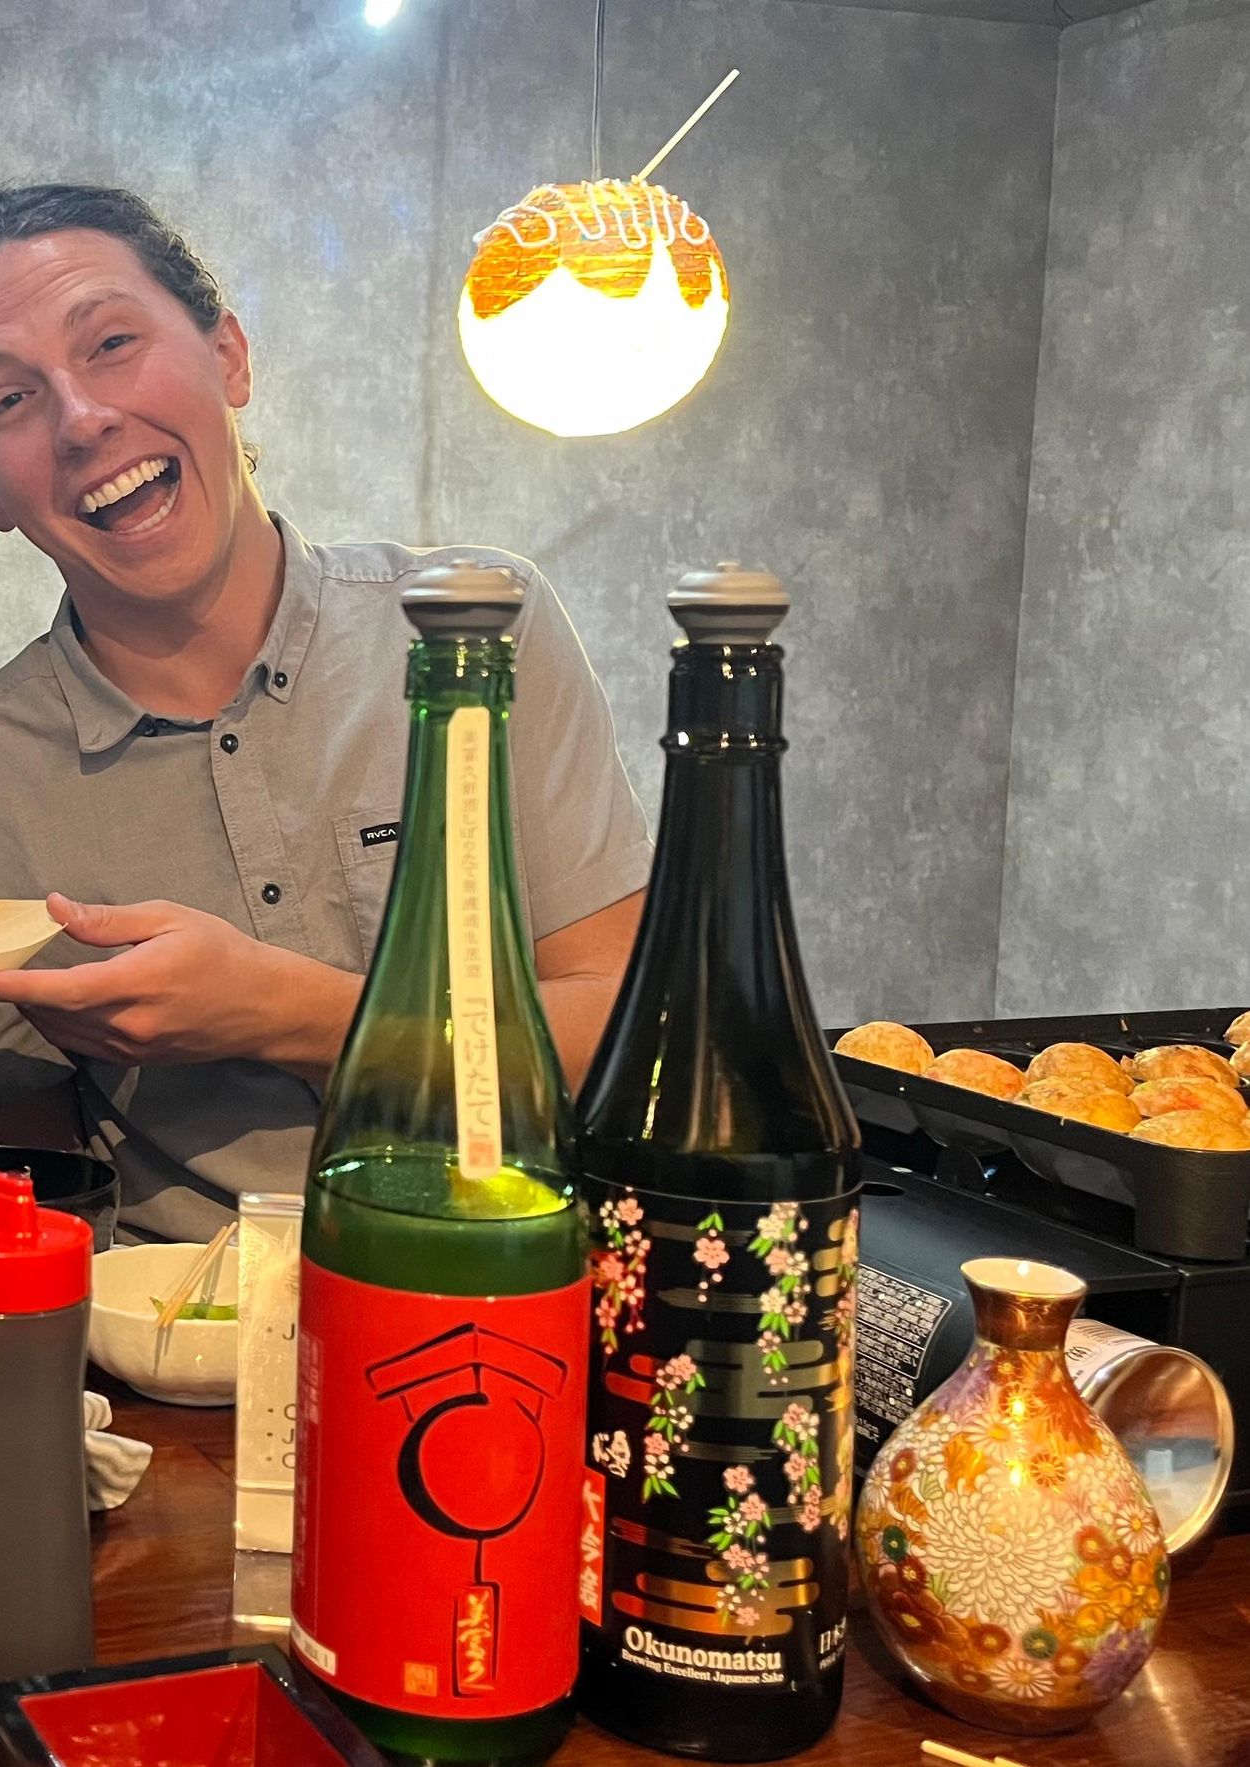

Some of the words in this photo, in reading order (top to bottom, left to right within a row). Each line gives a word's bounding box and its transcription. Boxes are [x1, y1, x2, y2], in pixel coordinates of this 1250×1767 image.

[366, 828, 397, 840] RVCA
[621, 1648, 662, 1674] Brewing
[663, 1661, 712, 1682] Excellent
[712, 1671, 760, 1686] Japanese
[761, 1671, 785, 1684] Sake
[624, 1625, 782, 1671] Okunomatsu
